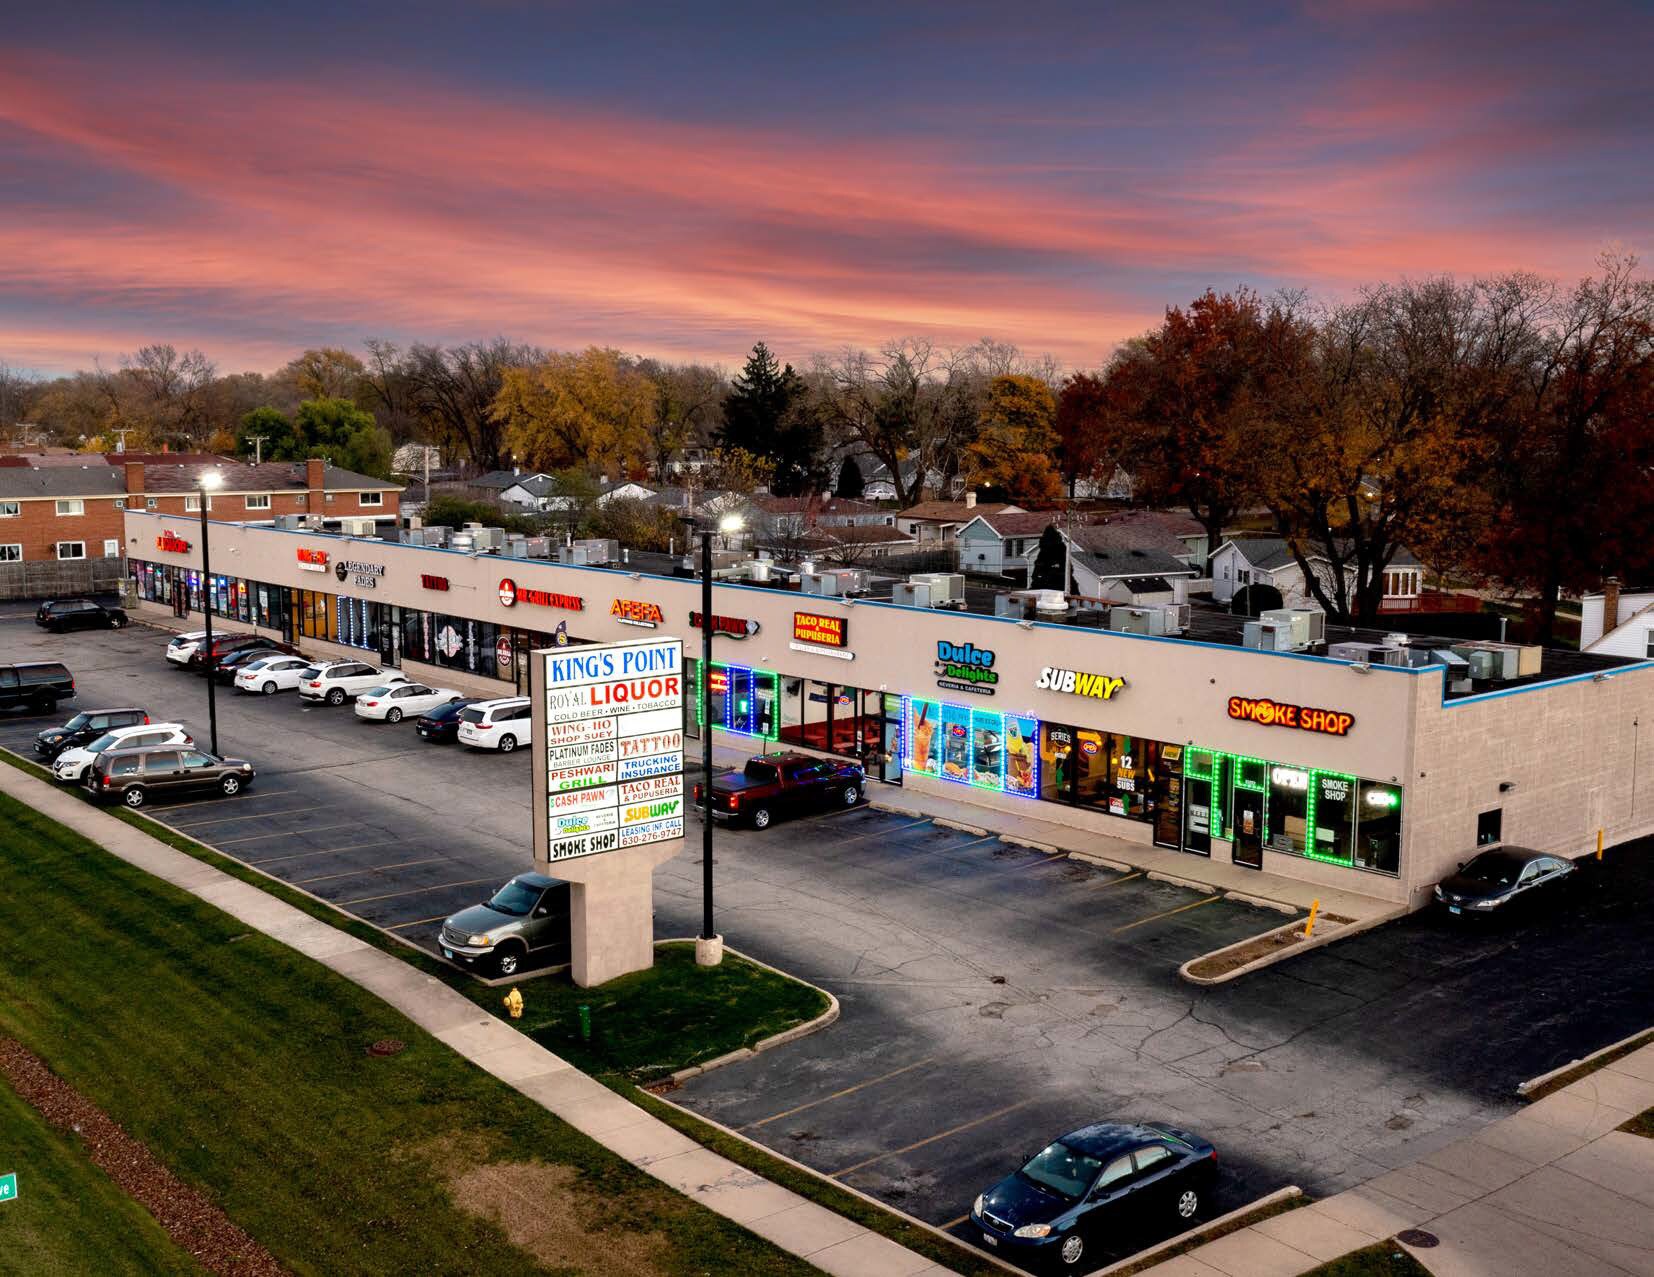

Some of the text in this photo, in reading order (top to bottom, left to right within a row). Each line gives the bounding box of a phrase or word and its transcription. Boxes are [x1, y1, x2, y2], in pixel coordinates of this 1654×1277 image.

[345, 561, 385, 577] LEGENDARY
[610, 599, 664, 622] AFEFA
[795, 613, 841, 633] TACO REAL
[795, 627, 841, 645] PUPUSERIA
[937, 641, 995, 668] Dulce
[552, 647, 676, 682] KING'S POINT
[946, 664, 998, 684] Delights
[1035, 666, 1125, 700] SUBWAY
[550, 677, 679, 710] ROYAL LIQUOR
[554, 699, 676, 721] COLD BEER WINE TOBACCO
[1230, 698, 1351, 735] SMOKE SHOP
[550, 730, 613, 745] SHOP SUEY
[620, 733, 681, 757] TATTOO
[549, 741, 614, 760] PLATINUM FADES
[553, 755, 611, 768] BARBER LOUNGE
[624, 754, 678, 770] TRUCKING
[1120, 755, 1132, 769] 12
[551, 763, 615, 780] PESHWARI
[621, 763, 681, 780] INSURANCE
[1117, 767, 1136, 779] NEW
[559, 776, 607, 791] GRILL
[622, 776, 681, 795] TACO REAL
[1116, 780, 1136, 792] SUBS
[1321, 778, 1349, 792] SMOKE
[580, 789, 604, 804] PAWN
[632, 786, 679, 801] PUPUSERIA
[1324, 789, 1346, 801] SHOP
[624, 800, 680, 823] SUBWAY
[557, 816, 589, 828] Dulce
[621, 824, 651, 838] LEASING
[665, 819, 682, 829] CALL
[553, 833, 616, 858] SMOKE SHOP
[622, 827, 682, 846] 630-276-9747
